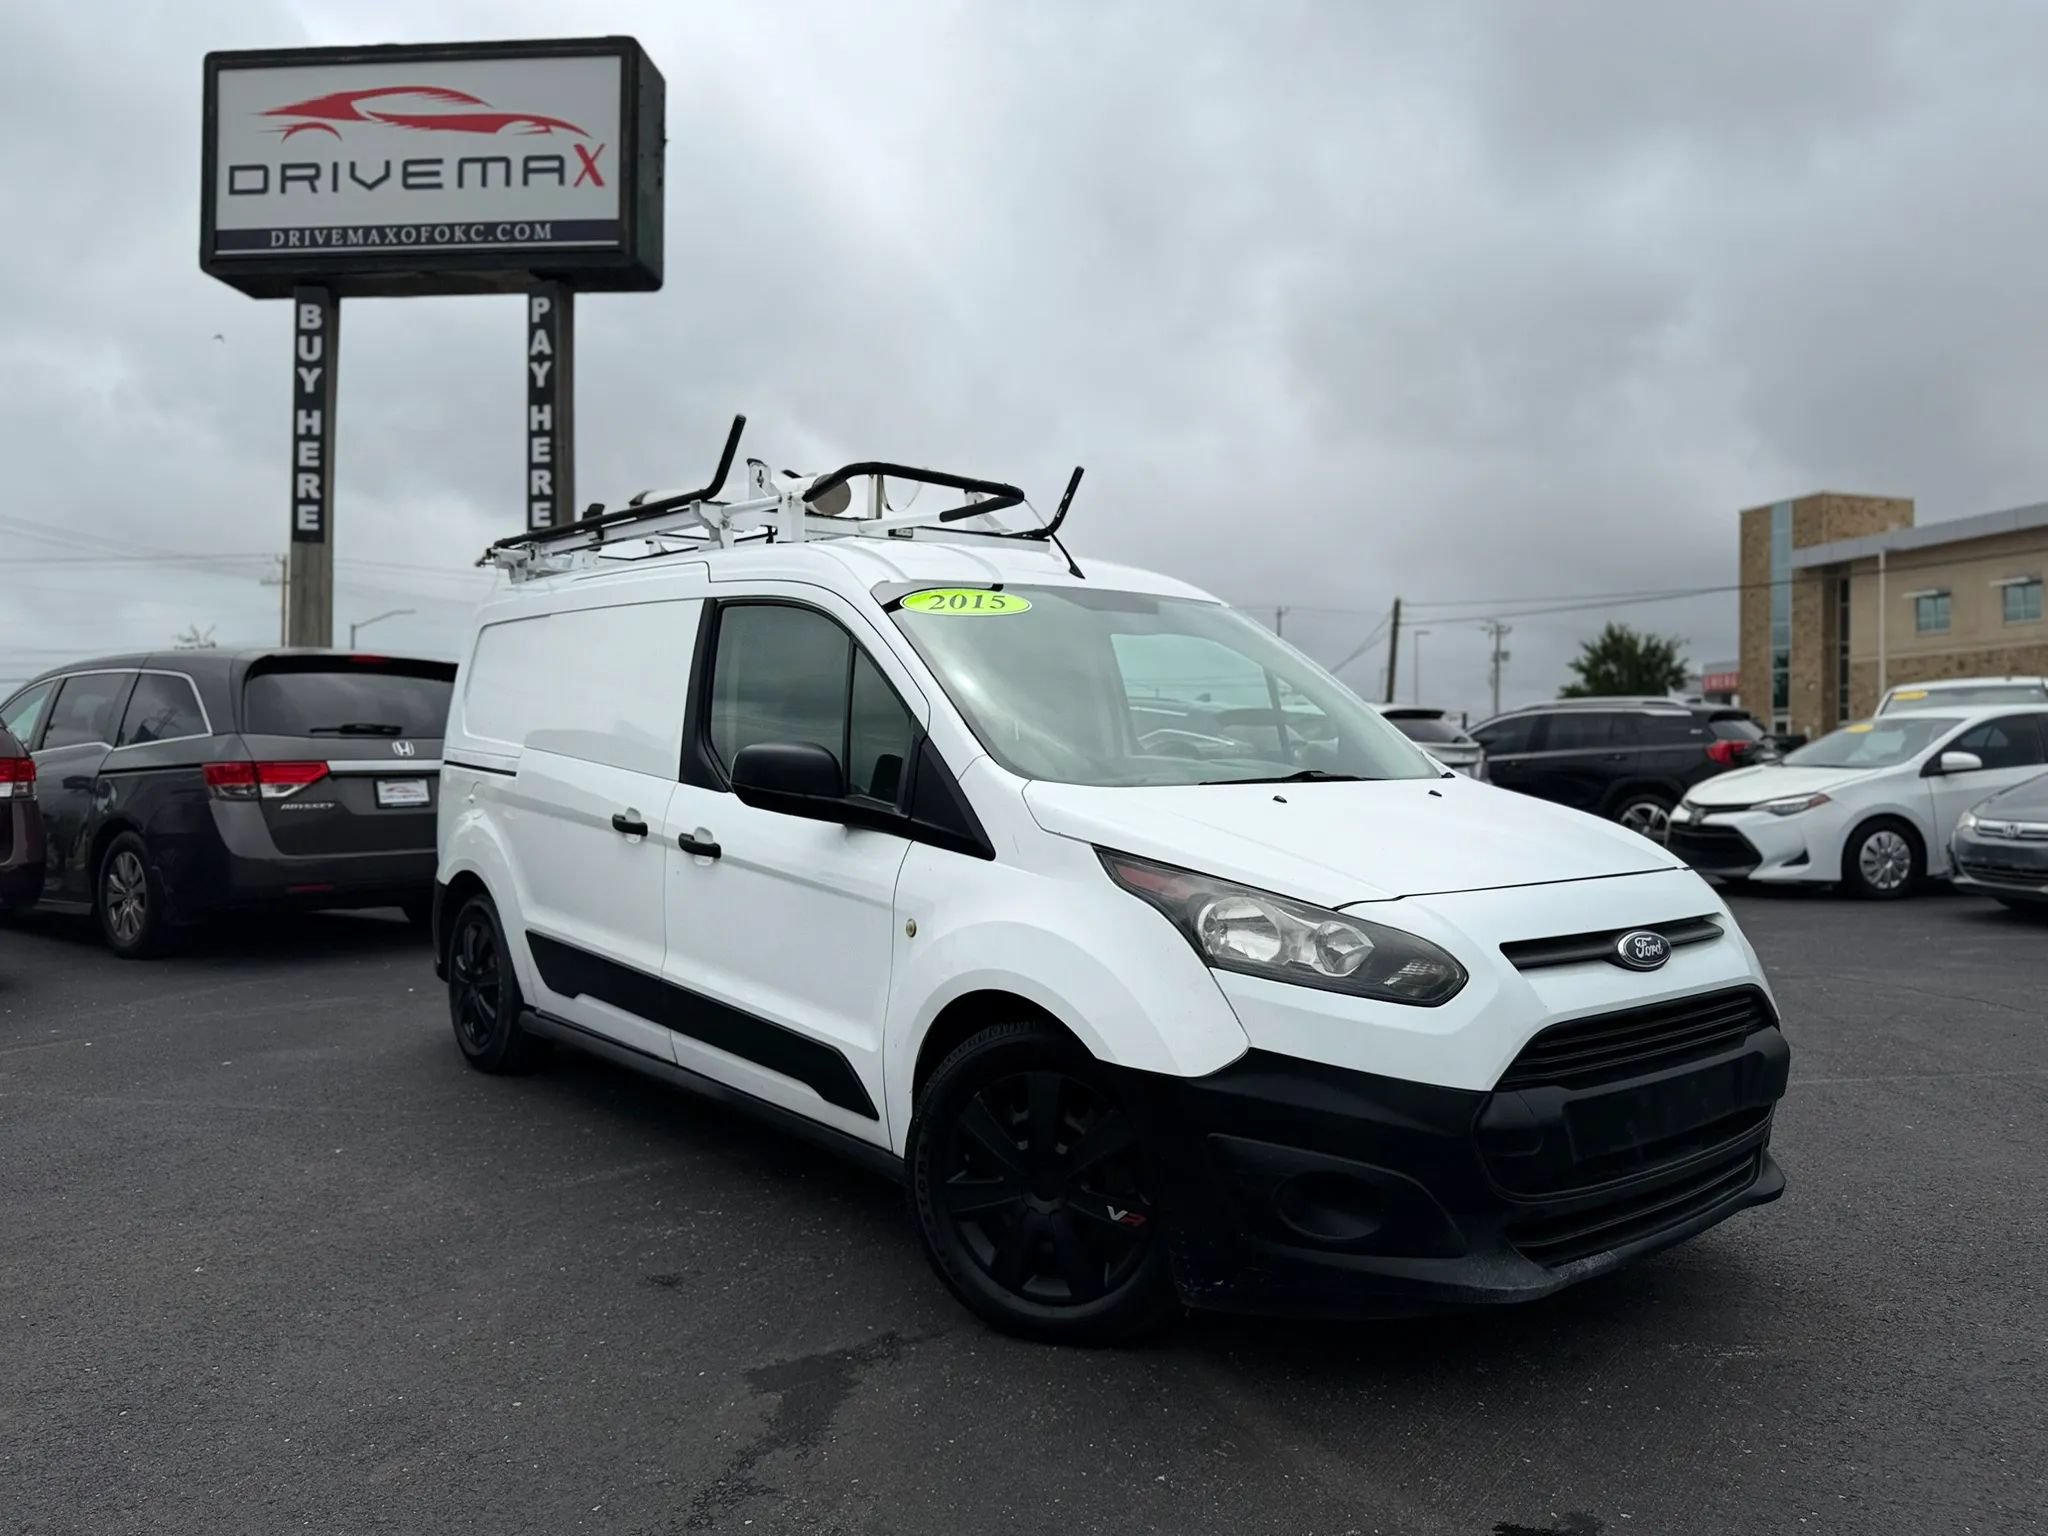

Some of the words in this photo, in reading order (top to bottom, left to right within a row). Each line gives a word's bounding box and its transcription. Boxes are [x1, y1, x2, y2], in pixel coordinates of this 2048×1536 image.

[228, 143, 606, 196] DRIVEMAX
[269, 222, 553, 247] DRIVEMAXOFOKC.COM
[297, 303, 322, 393] BUY
[529, 297, 552, 388] PAY
[296, 409, 322, 530] HERE
[529, 404, 553, 528] HERE
[928, 593, 1006, 610] 2015
[1634, 936, 1664, 958] Ford
